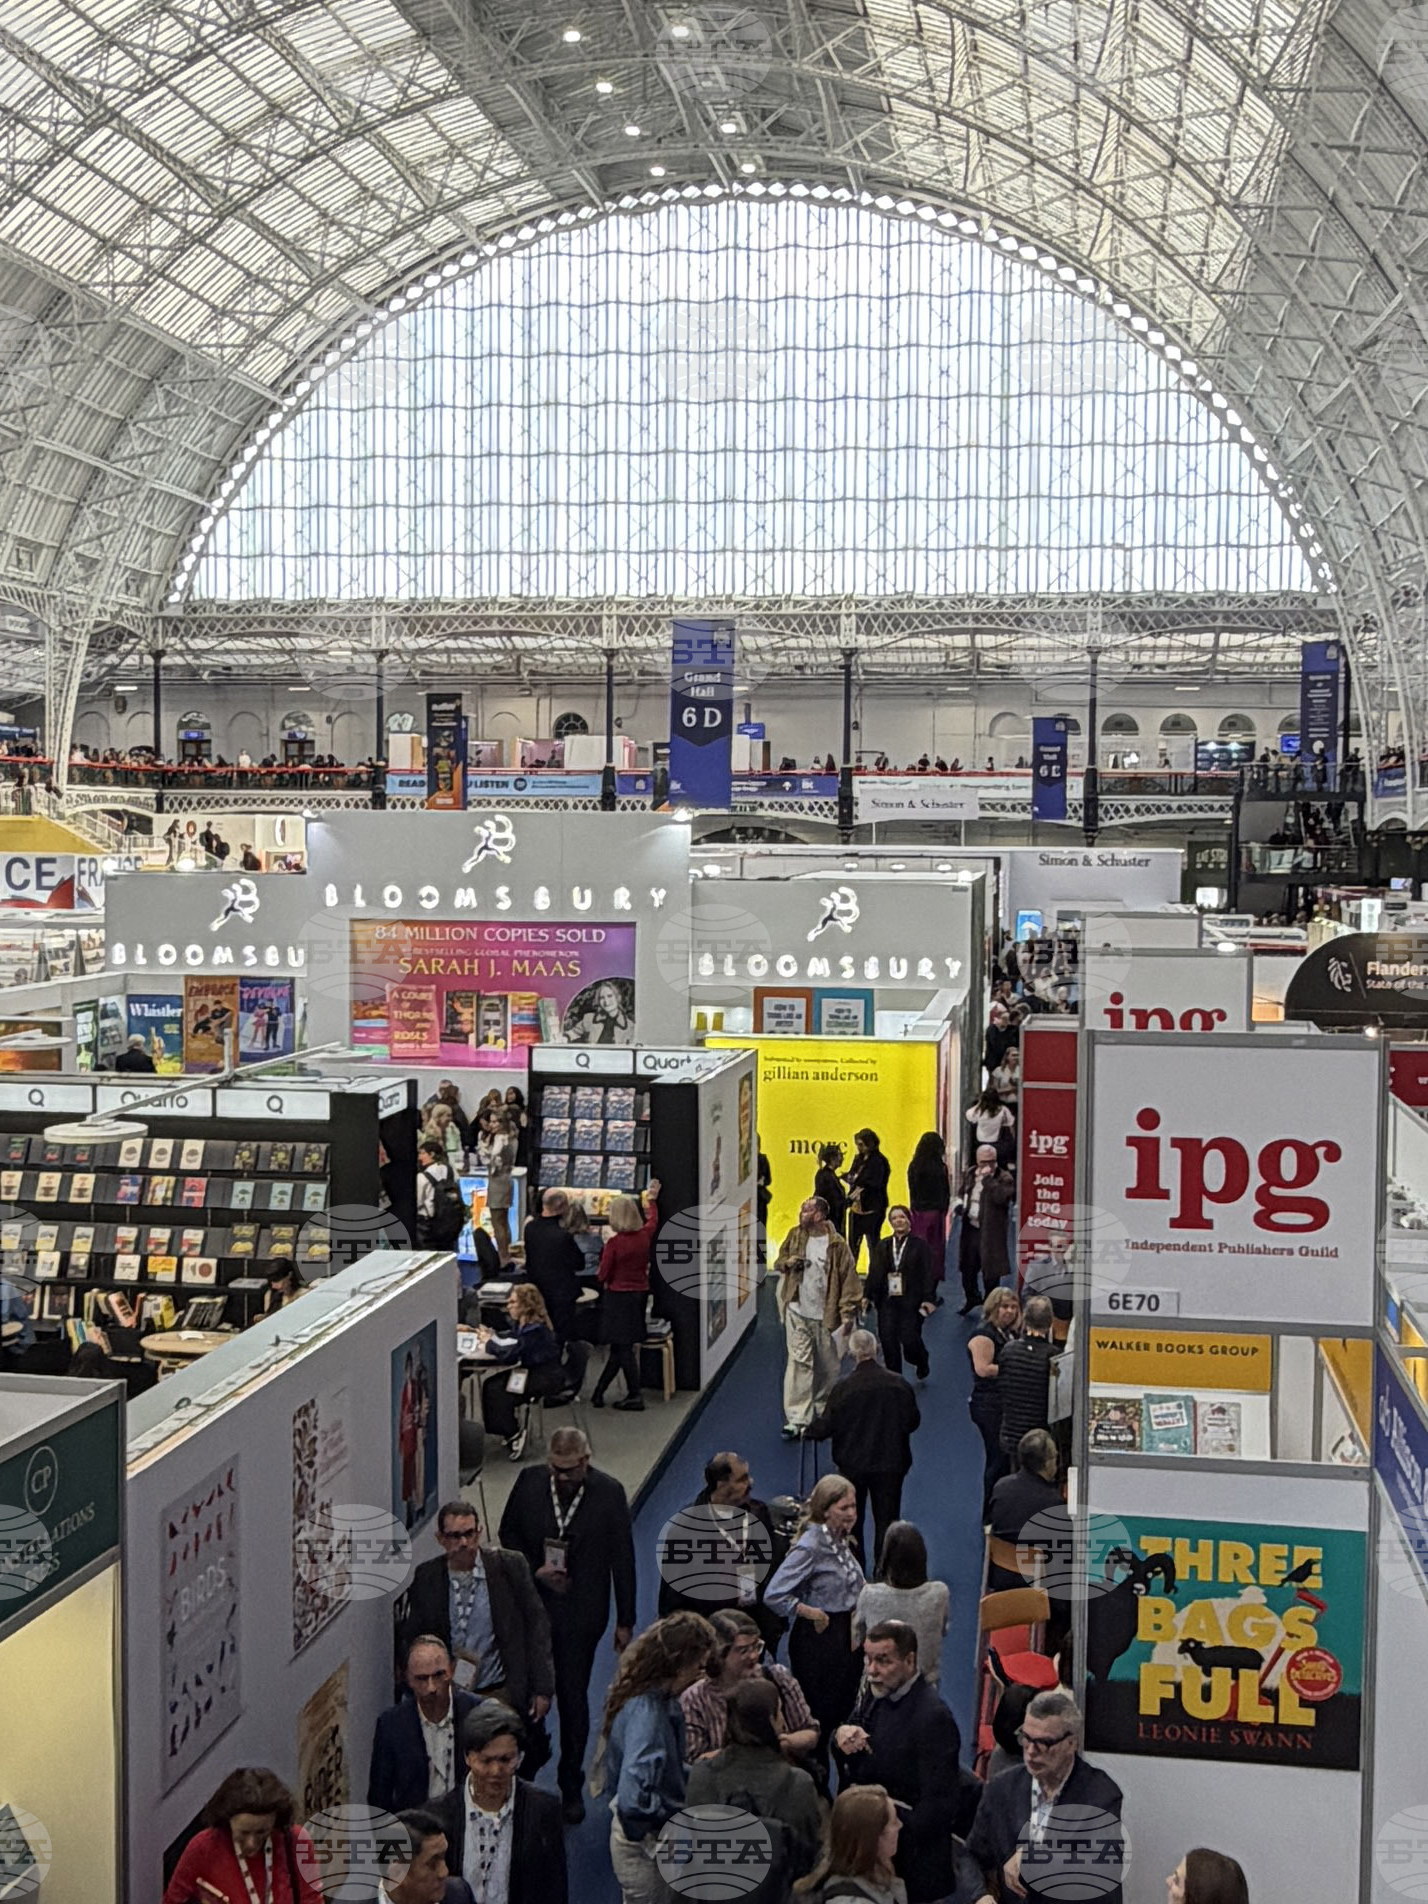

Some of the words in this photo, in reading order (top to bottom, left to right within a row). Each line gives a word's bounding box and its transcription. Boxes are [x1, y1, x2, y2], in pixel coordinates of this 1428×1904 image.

[682, 707, 697, 727] 6
[703, 707, 722, 727] D
[1039, 853, 1080, 866] Simon
[1083, 854, 1094, 867] &
[1097, 854, 1151, 868] Schuster
[325, 883, 667, 911] BLOOMSBURY
[404, 927, 477, 942] MILLION
[484, 927, 550, 942] COPIES
[556, 929, 606, 943] SOLD
[111, 942, 305, 967] BLOOMSBU
[399, 957, 479, 976] SARAH
[489, 960, 502, 978] J.
[512, 960, 582, 977] MAAS
[763, 1065, 810, 1082] gillian
[812, 1067, 879, 1082] anderson
[1125, 1107, 1342, 1233] ipg
[1108, 1292, 1161, 1312] 6E70
[1156, 1342, 1204, 1355] BOOKS
[1209, 1344, 1259, 1357] GROUP
[1139, 1536, 1323, 1589] THREE
[1137, 1595, 1318, 1652] BAGS
[1139, 1662, 1317, 1727] FULL
[1138, 1721, 1222, 1743] LEONIE
[1230, 1728, 1313, 1750] SWANN
